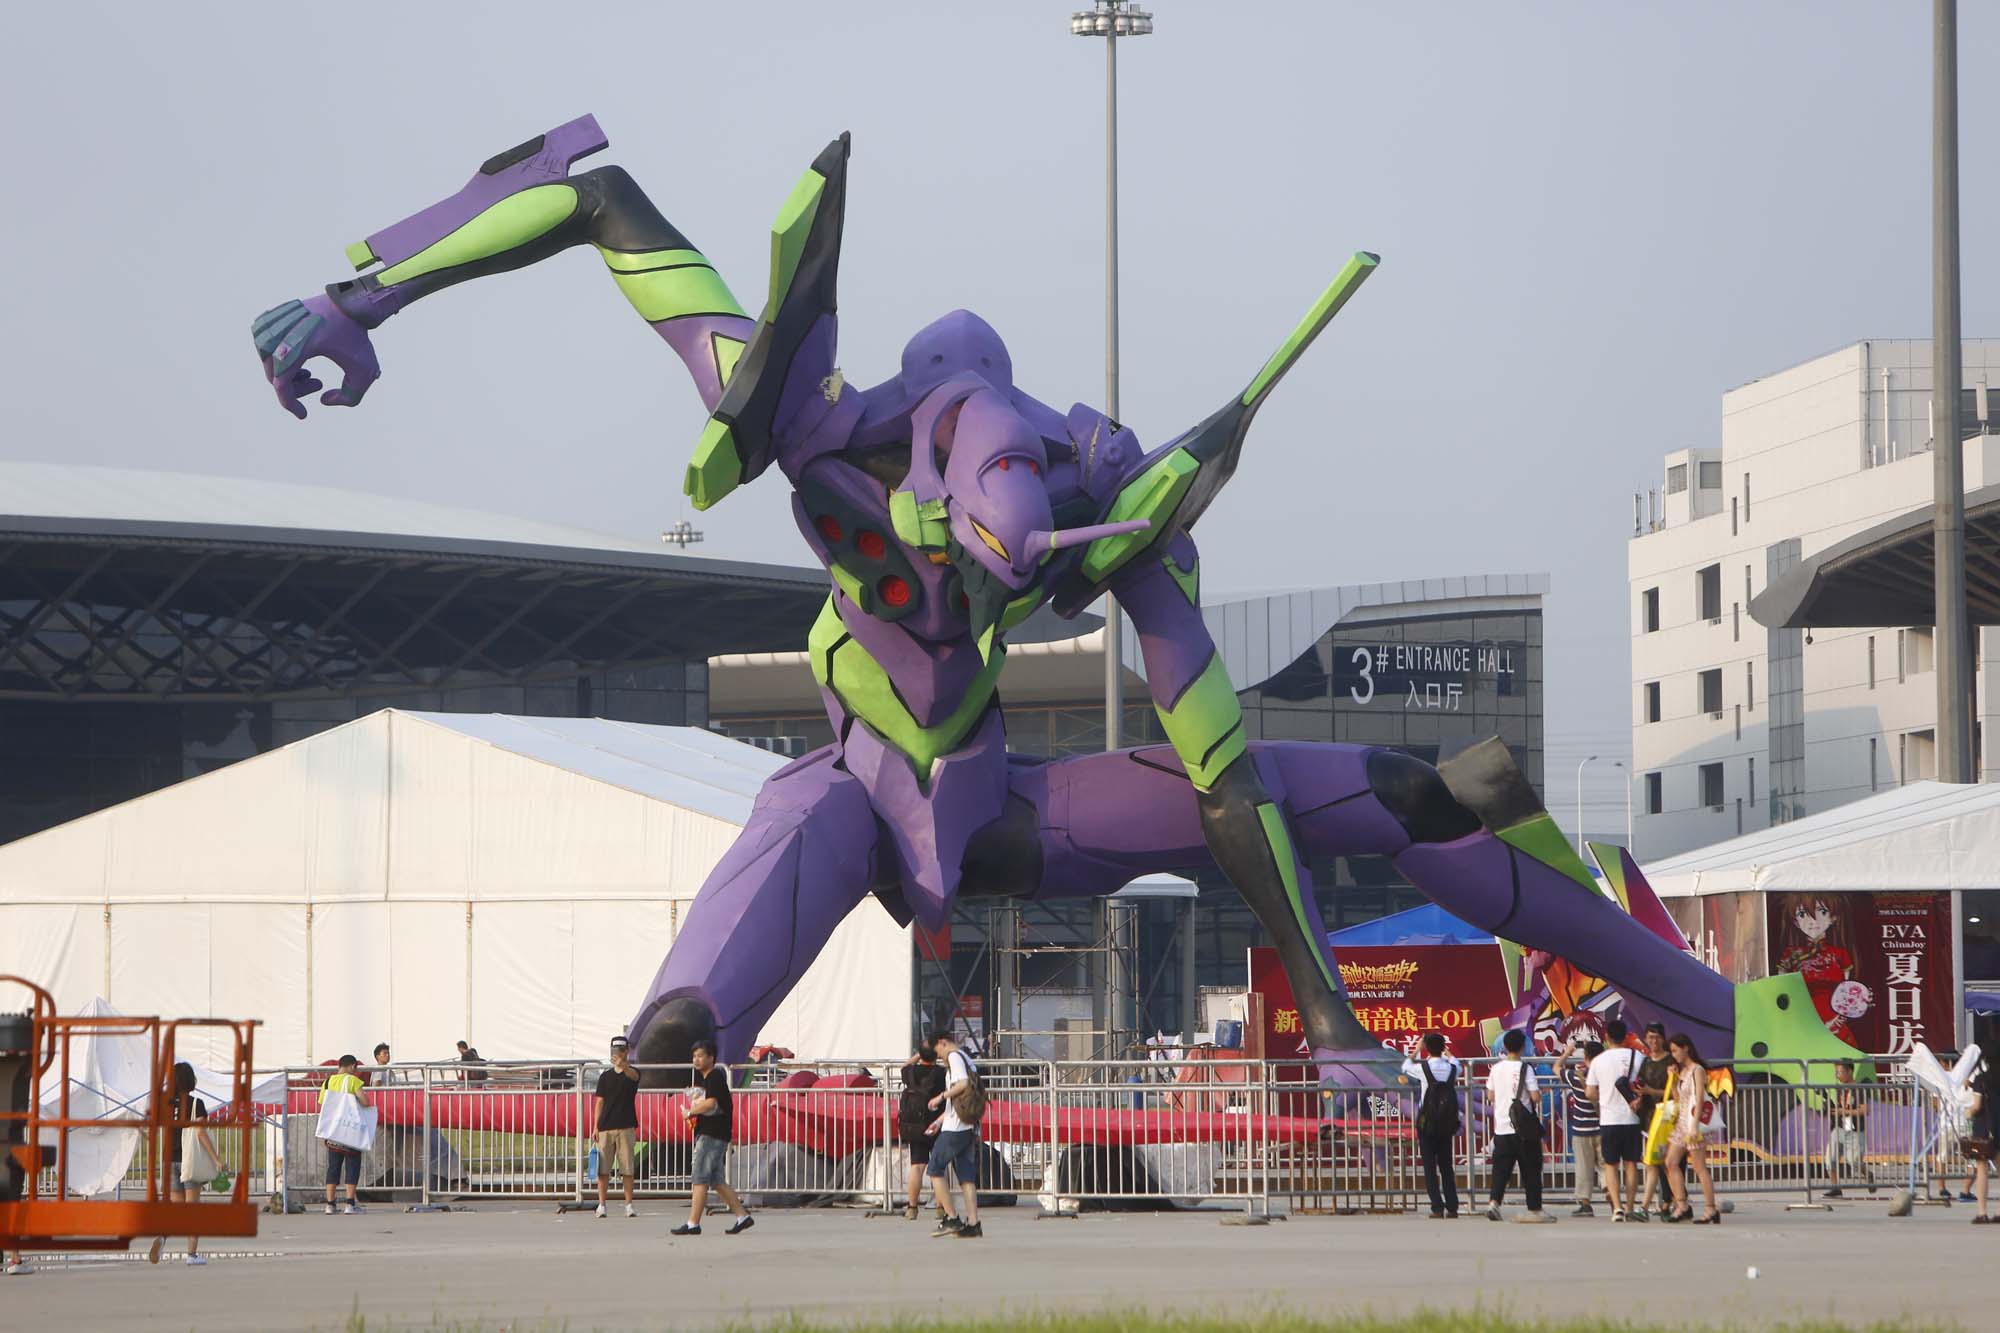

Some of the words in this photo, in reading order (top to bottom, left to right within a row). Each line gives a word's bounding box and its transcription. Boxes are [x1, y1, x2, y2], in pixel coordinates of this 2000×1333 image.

[1396, 646, 1471, 672] ENTRANCE
[1478, 648, 1515, 673] HALL
[1405, 680, 1463, 711] 入口厅
[1881, 924, 1926, 939] EVA
[1881, 941, 1926, 950] ChinaJoy
